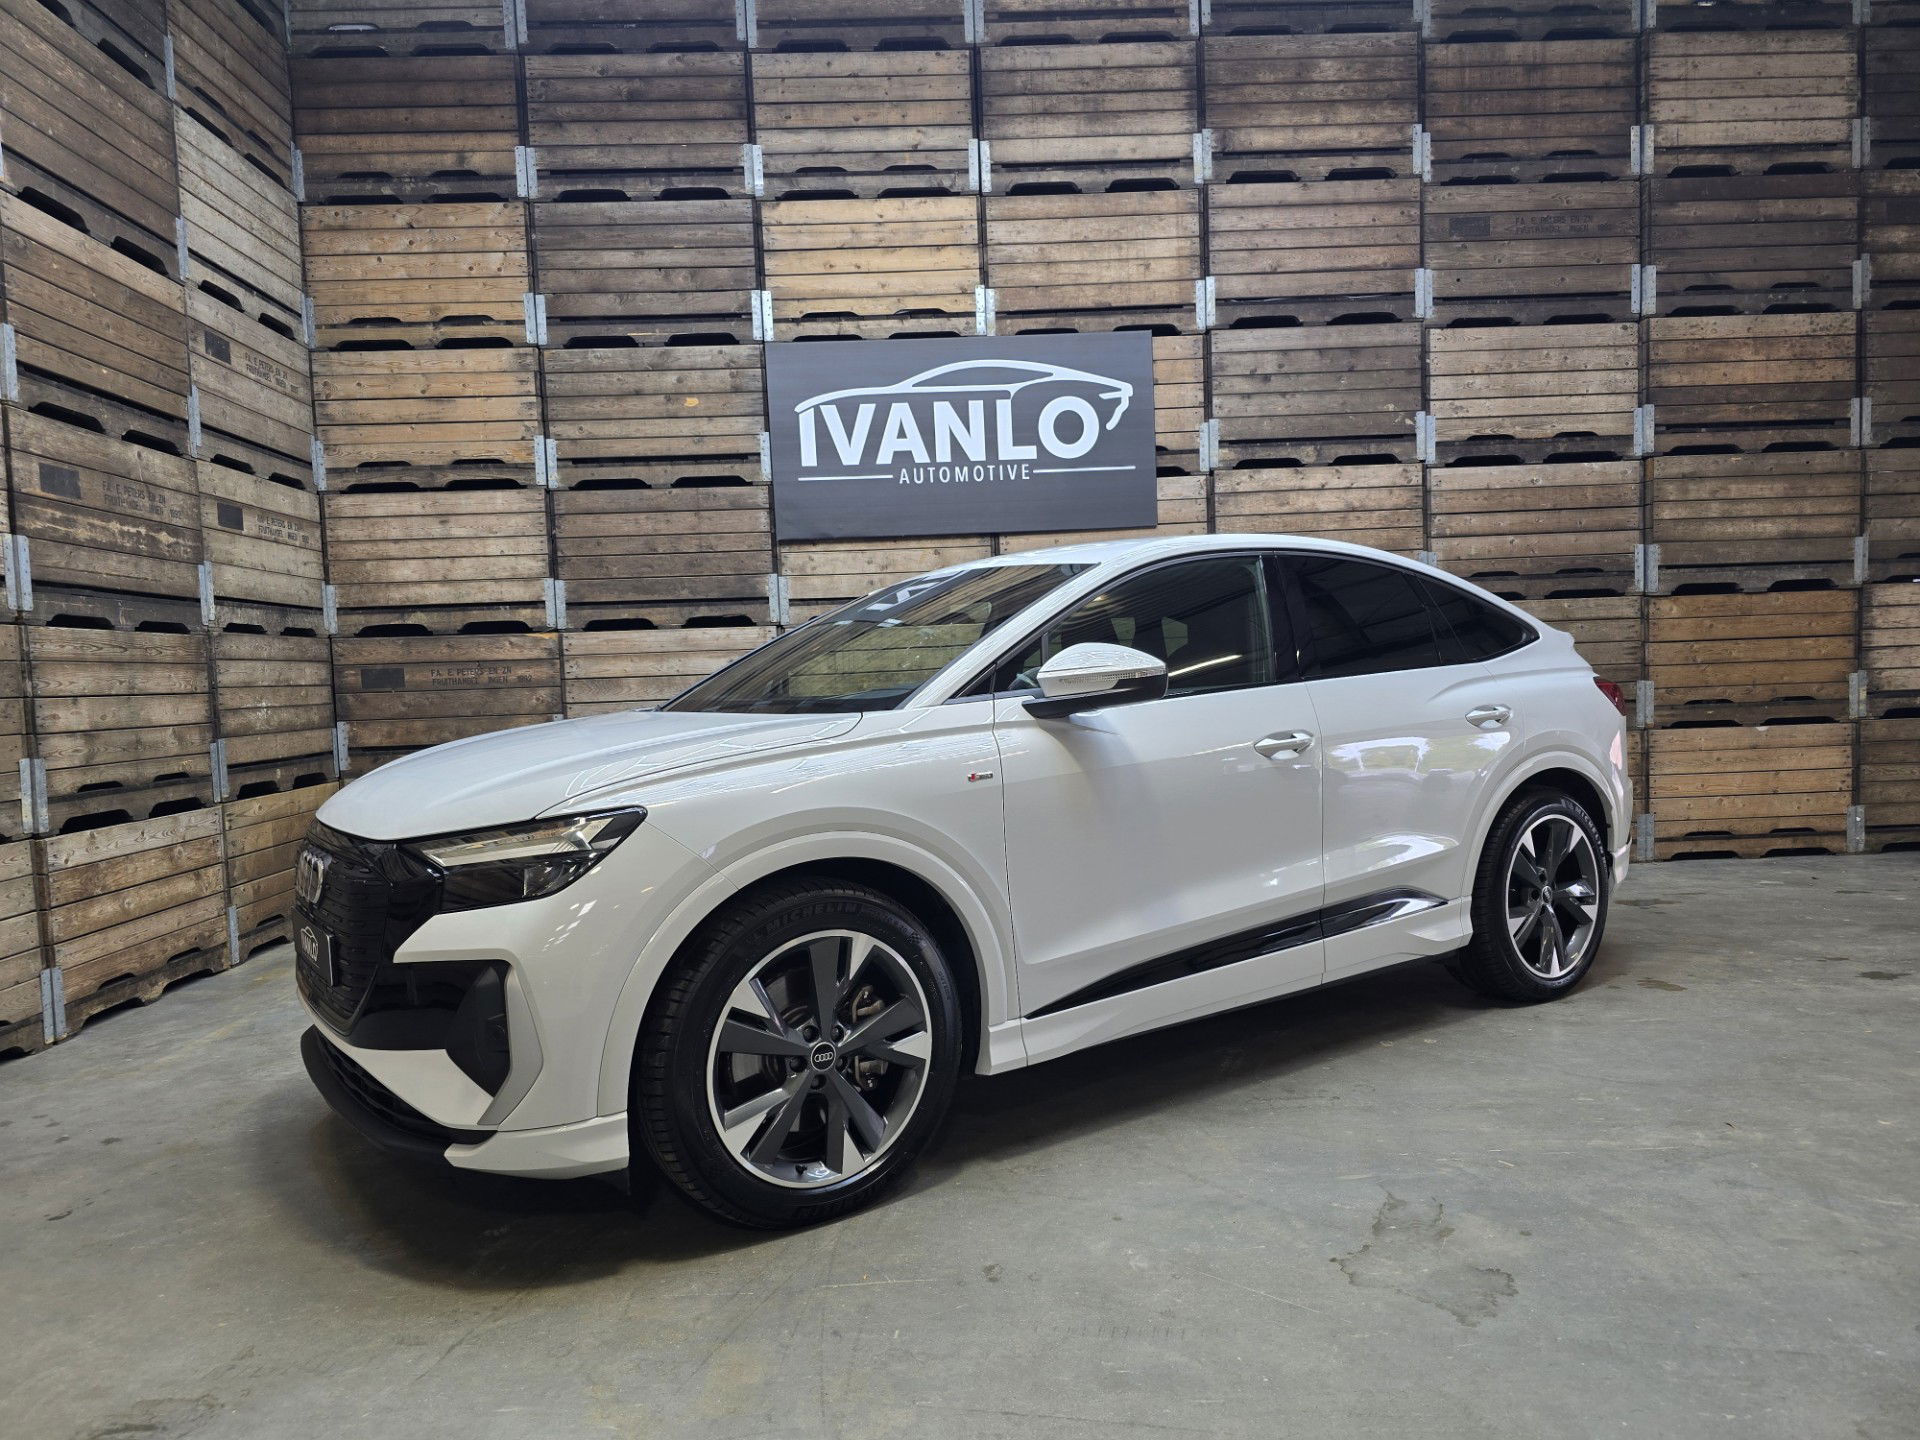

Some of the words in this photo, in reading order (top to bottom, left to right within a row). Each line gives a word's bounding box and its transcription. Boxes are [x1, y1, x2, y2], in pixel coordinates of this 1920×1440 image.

[799, 395, 1100, 467] IVANLO
[899, 463, 1031, 485] AUTOMOTIVE
[430, 669, 441, 678] FA
[447, 668, 454, 676] E
[457, 667, 484, 676] PETERS
[502, 665, 513, 674] ZN
[766, 902, 858, 930] MICHELIN
